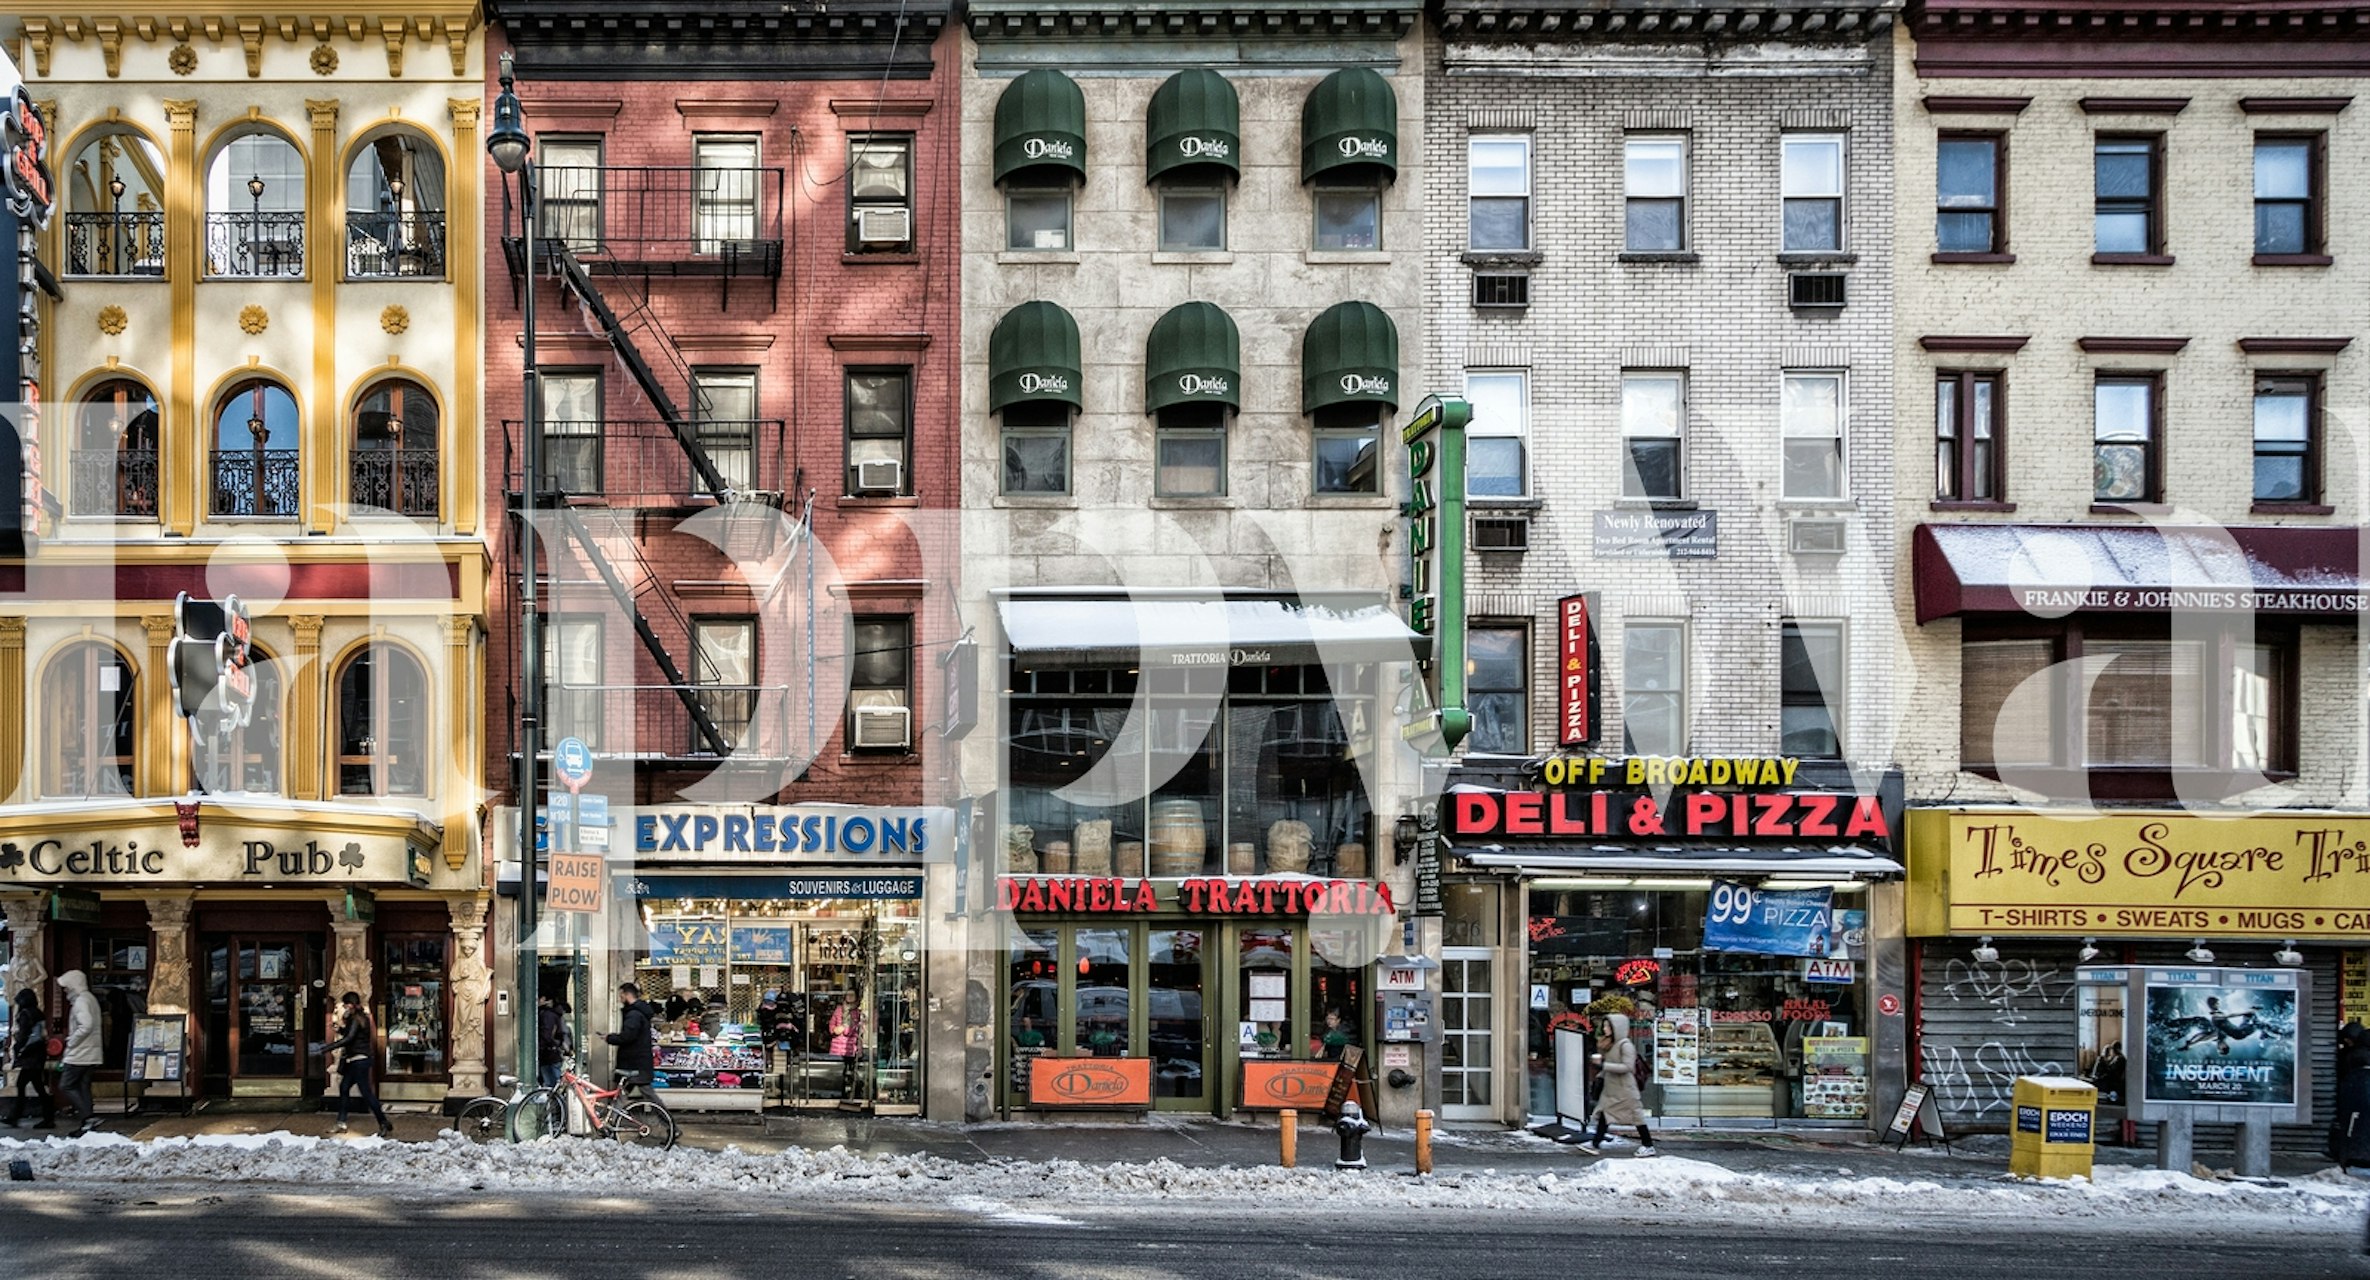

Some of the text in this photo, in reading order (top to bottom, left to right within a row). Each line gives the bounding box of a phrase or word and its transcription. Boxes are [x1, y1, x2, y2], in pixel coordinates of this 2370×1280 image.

[1604, 514, 1706, 532] Newly Renovated
[2025, 590, 2368, 612] FRANKIE & JOHNNIE'S STEAKHOUSE
[1567, 602, 1582, 653] DELI
[1172, 649, 1271, 667] TRATTORIA Daniela
[1567, 657, 1581, 671] &
[1567, 675, 1583, 740] PIZZA
[1545, 757, 1800, 786] OFF BROADWAY
[1456, 792, 1890, 837] DELI & PIZZA
[636, 814, 929, 853] EXPRESSIONS
[30, 840, 334, 875] Celtic Pub
[1966, 824, 2108, 887] Times
[2123, 822, 2284, 899] Square
[555, 860, 598, 878] RAISE
[552, 887, 598, 906] PLOW
[788, 879, 851, 896] SOUVENIRS
[862, 880, 915, 896] LUGGAGE
[996, 877, 1397, 915] DANIELA TRATTORIA
[1763, 907, 1829, 929] PIZZA
[1979, 908, 2087, 927] T-SHIRTS
[2117, 910, 2209, 928] SWEATS
[2238, 911, 2305, 930] MUGS
[263, 960, 275, 973] A
[1807, 961, 1853, 977] ATM
[1389, 969, 1415, 984] ATM
[2090, 971, 2116, 981] TITAN
[2165, 971, 2197, 981] TITAN
[2245, 974, 2275, 984] TITAN
[1534, 988, 1545, 1001] A
[1711, 1009, 1773, 1023] ESPRESSO
[1781, 1009, 1832, 1022] FOODS
[1243, 1025, 1254, 1038] A
[2164, 1063, 2275, 1083] INSURGENT
[1056, 1072, 1125, 1094] Daniela
[2198, 1082, 2243, 1091] MARCH 20
[2049, 1111, 2089, 1123] EPOCH
